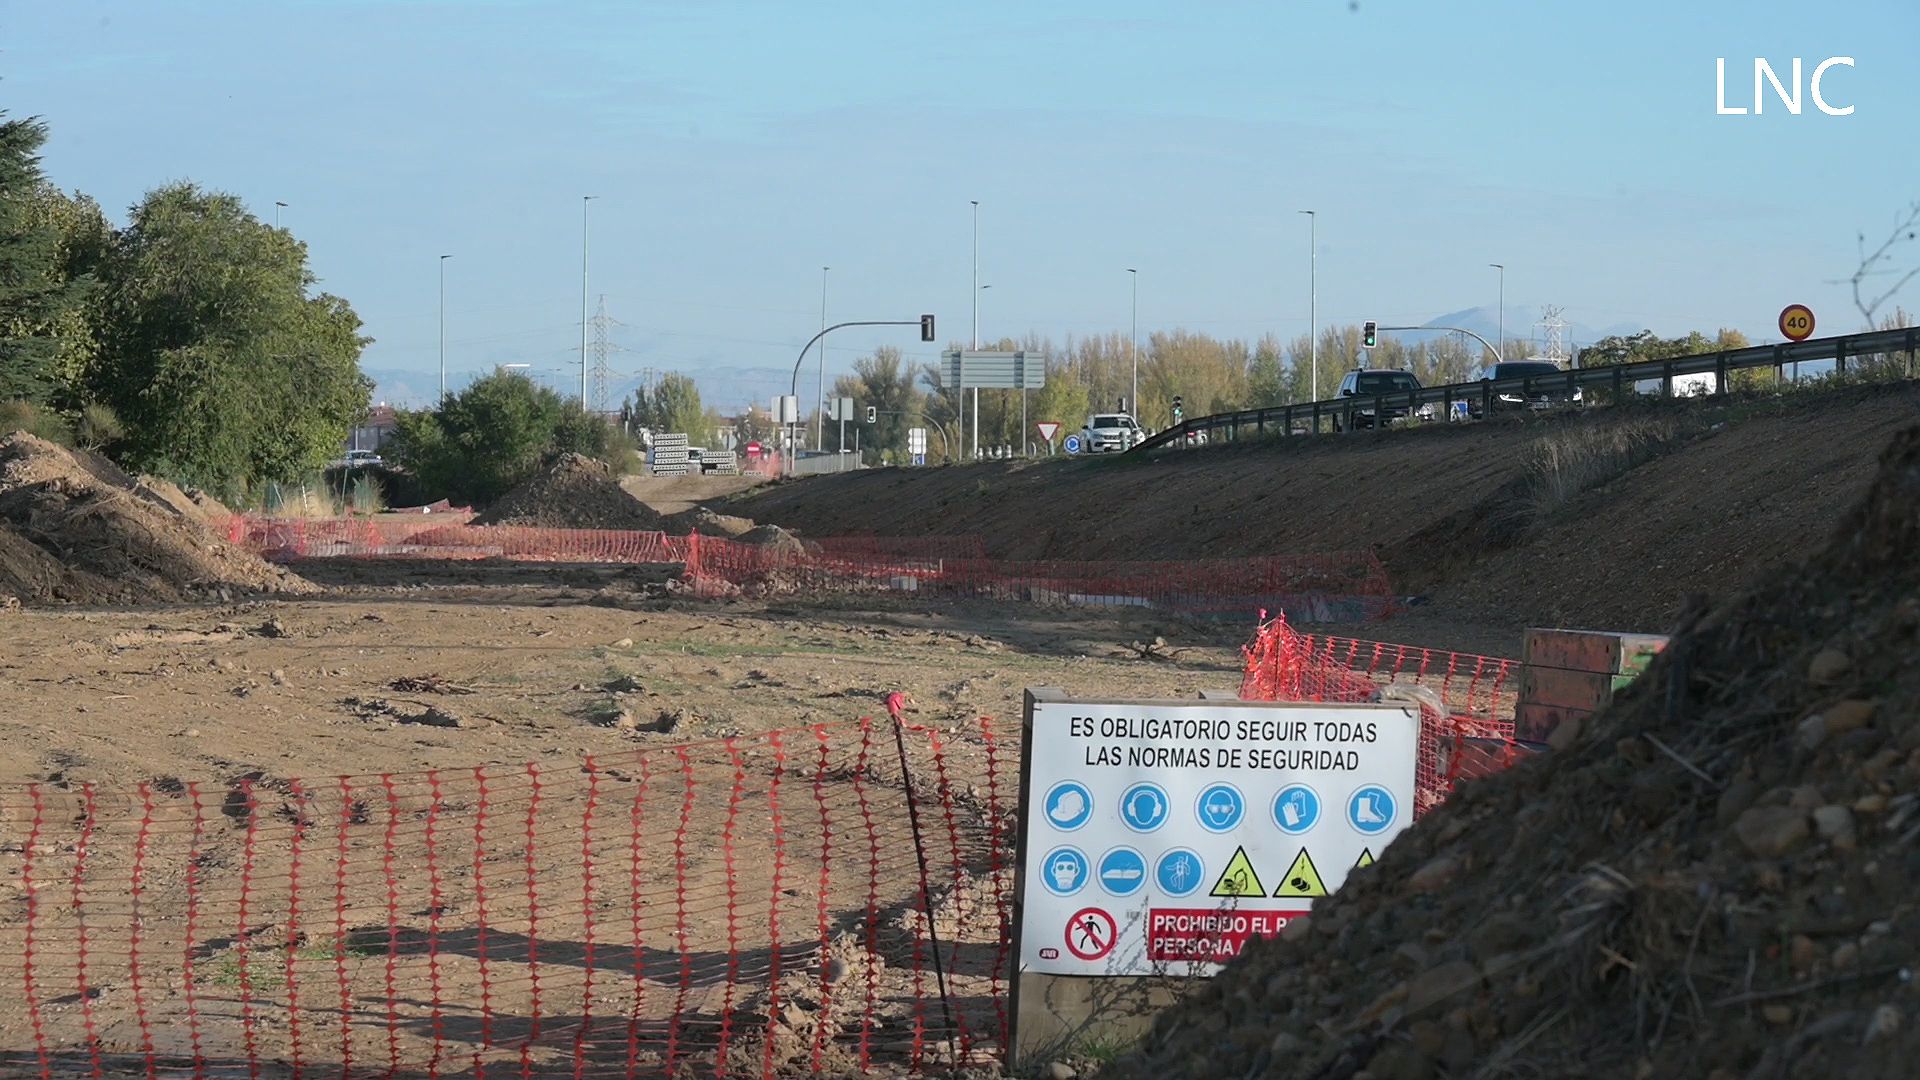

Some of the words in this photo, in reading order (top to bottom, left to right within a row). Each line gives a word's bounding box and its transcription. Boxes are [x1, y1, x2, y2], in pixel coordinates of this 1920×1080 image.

[1787, 316, 1808, 328] 40
[1070, 717, 1094, 737] ES
[1101, 717, 1231, 740] OBLIGATORIO
[1236, 720, 1307, 742] SEGUIR
[1313, 722, 1377, 743] TODAS
[1085, 745, 1122, 766] LAS
[1128, 746, 1210, 768] NORMAS
[1216, 748, 1242, 768] DE
[1248, 748, 1359, 771] SEGURIDAD
[1154, 914, 1247, 934] PROHIBIDO
[1251, 916, 1272, 934] EL
[1153, 937, 1234, 956] PERSONA
